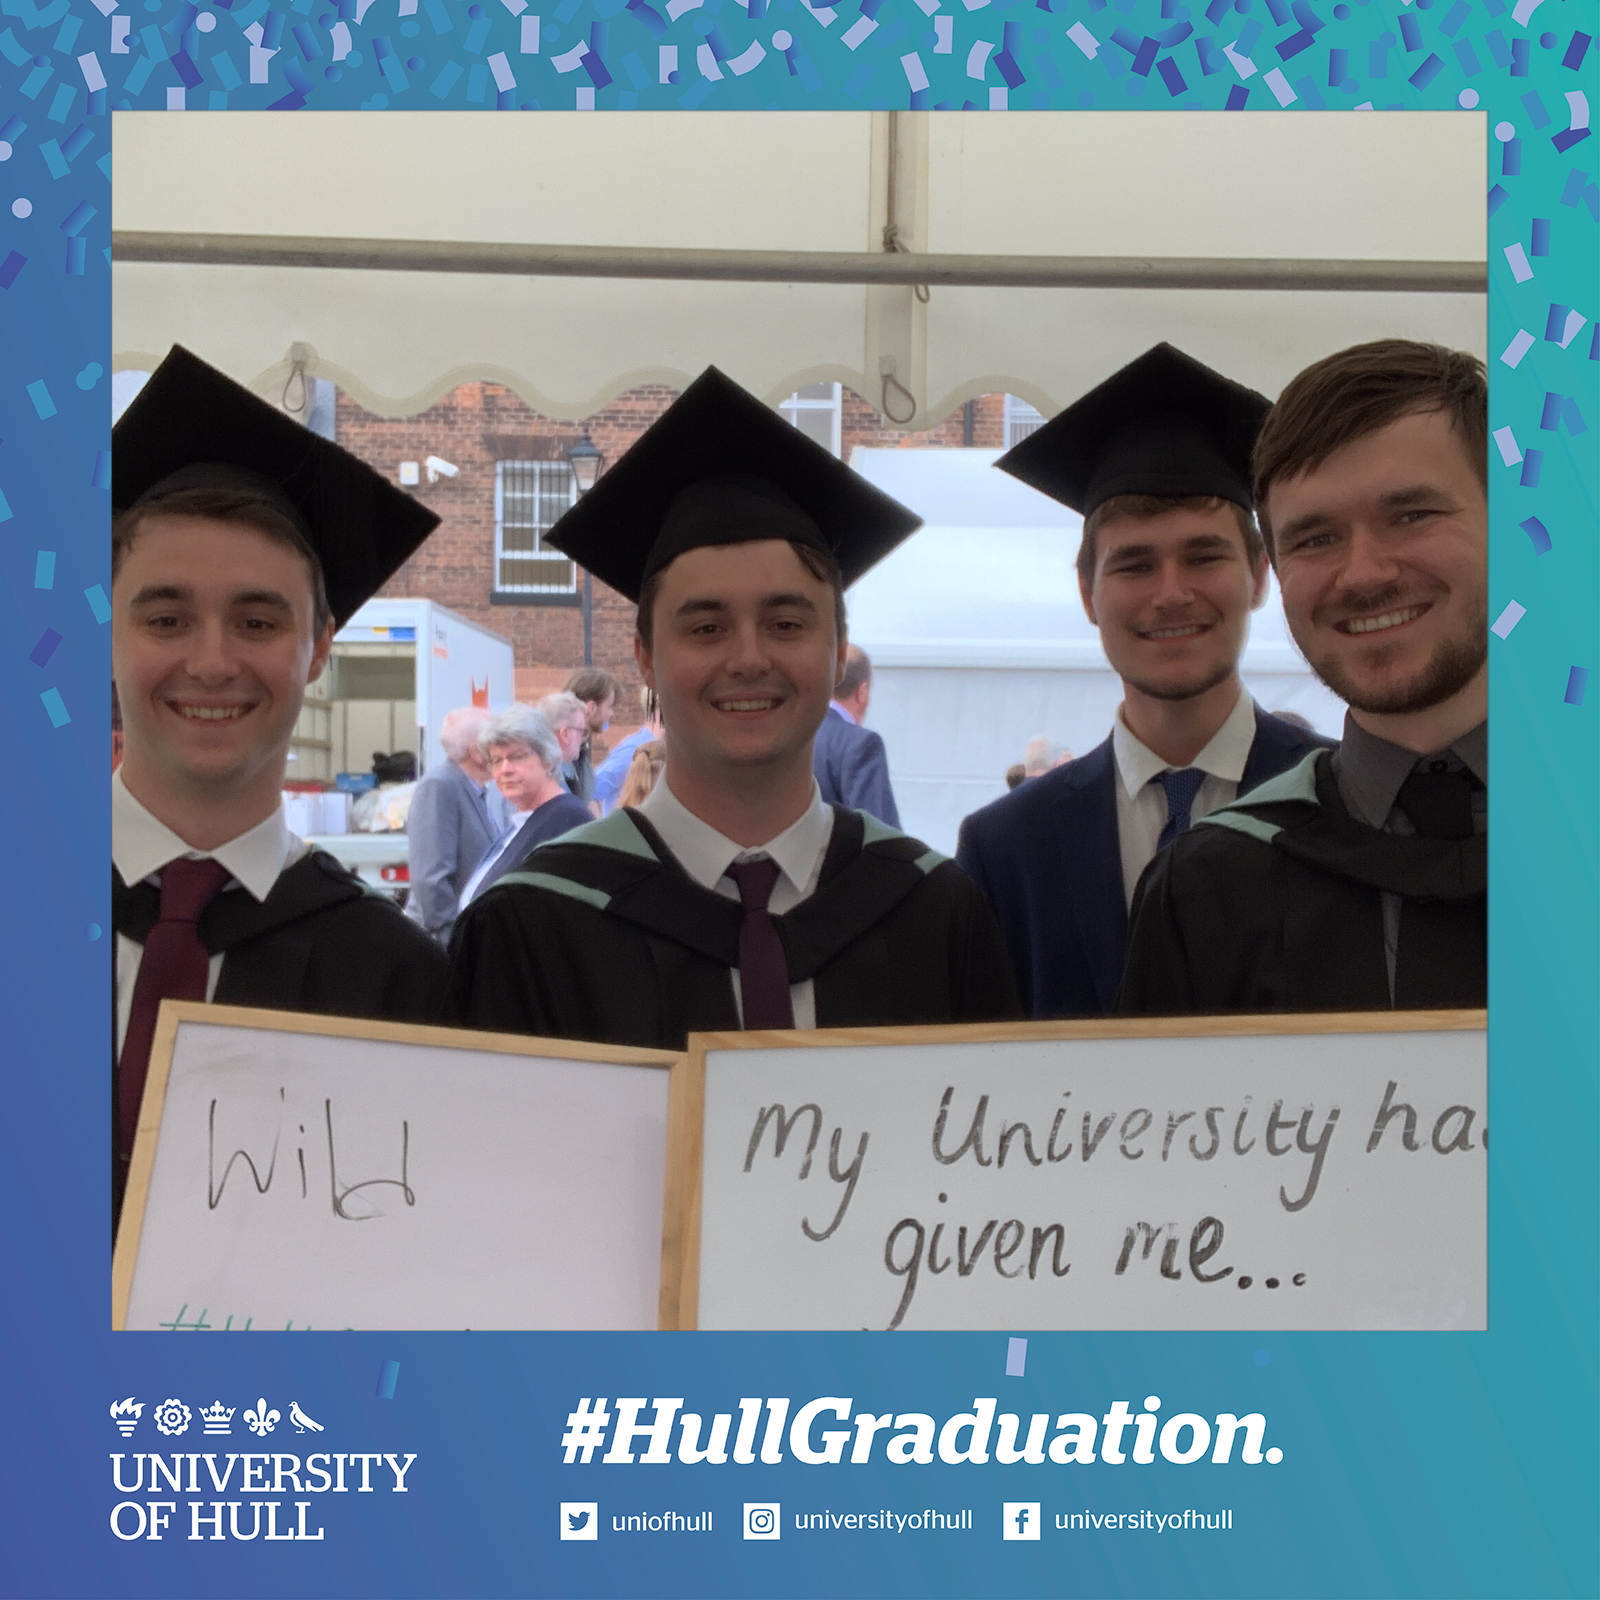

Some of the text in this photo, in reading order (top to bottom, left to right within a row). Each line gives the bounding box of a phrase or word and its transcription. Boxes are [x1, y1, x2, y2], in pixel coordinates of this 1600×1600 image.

[743, 1080, 1488, 1242] My University ha
[884, 1192, 1307, 1330] given me...
